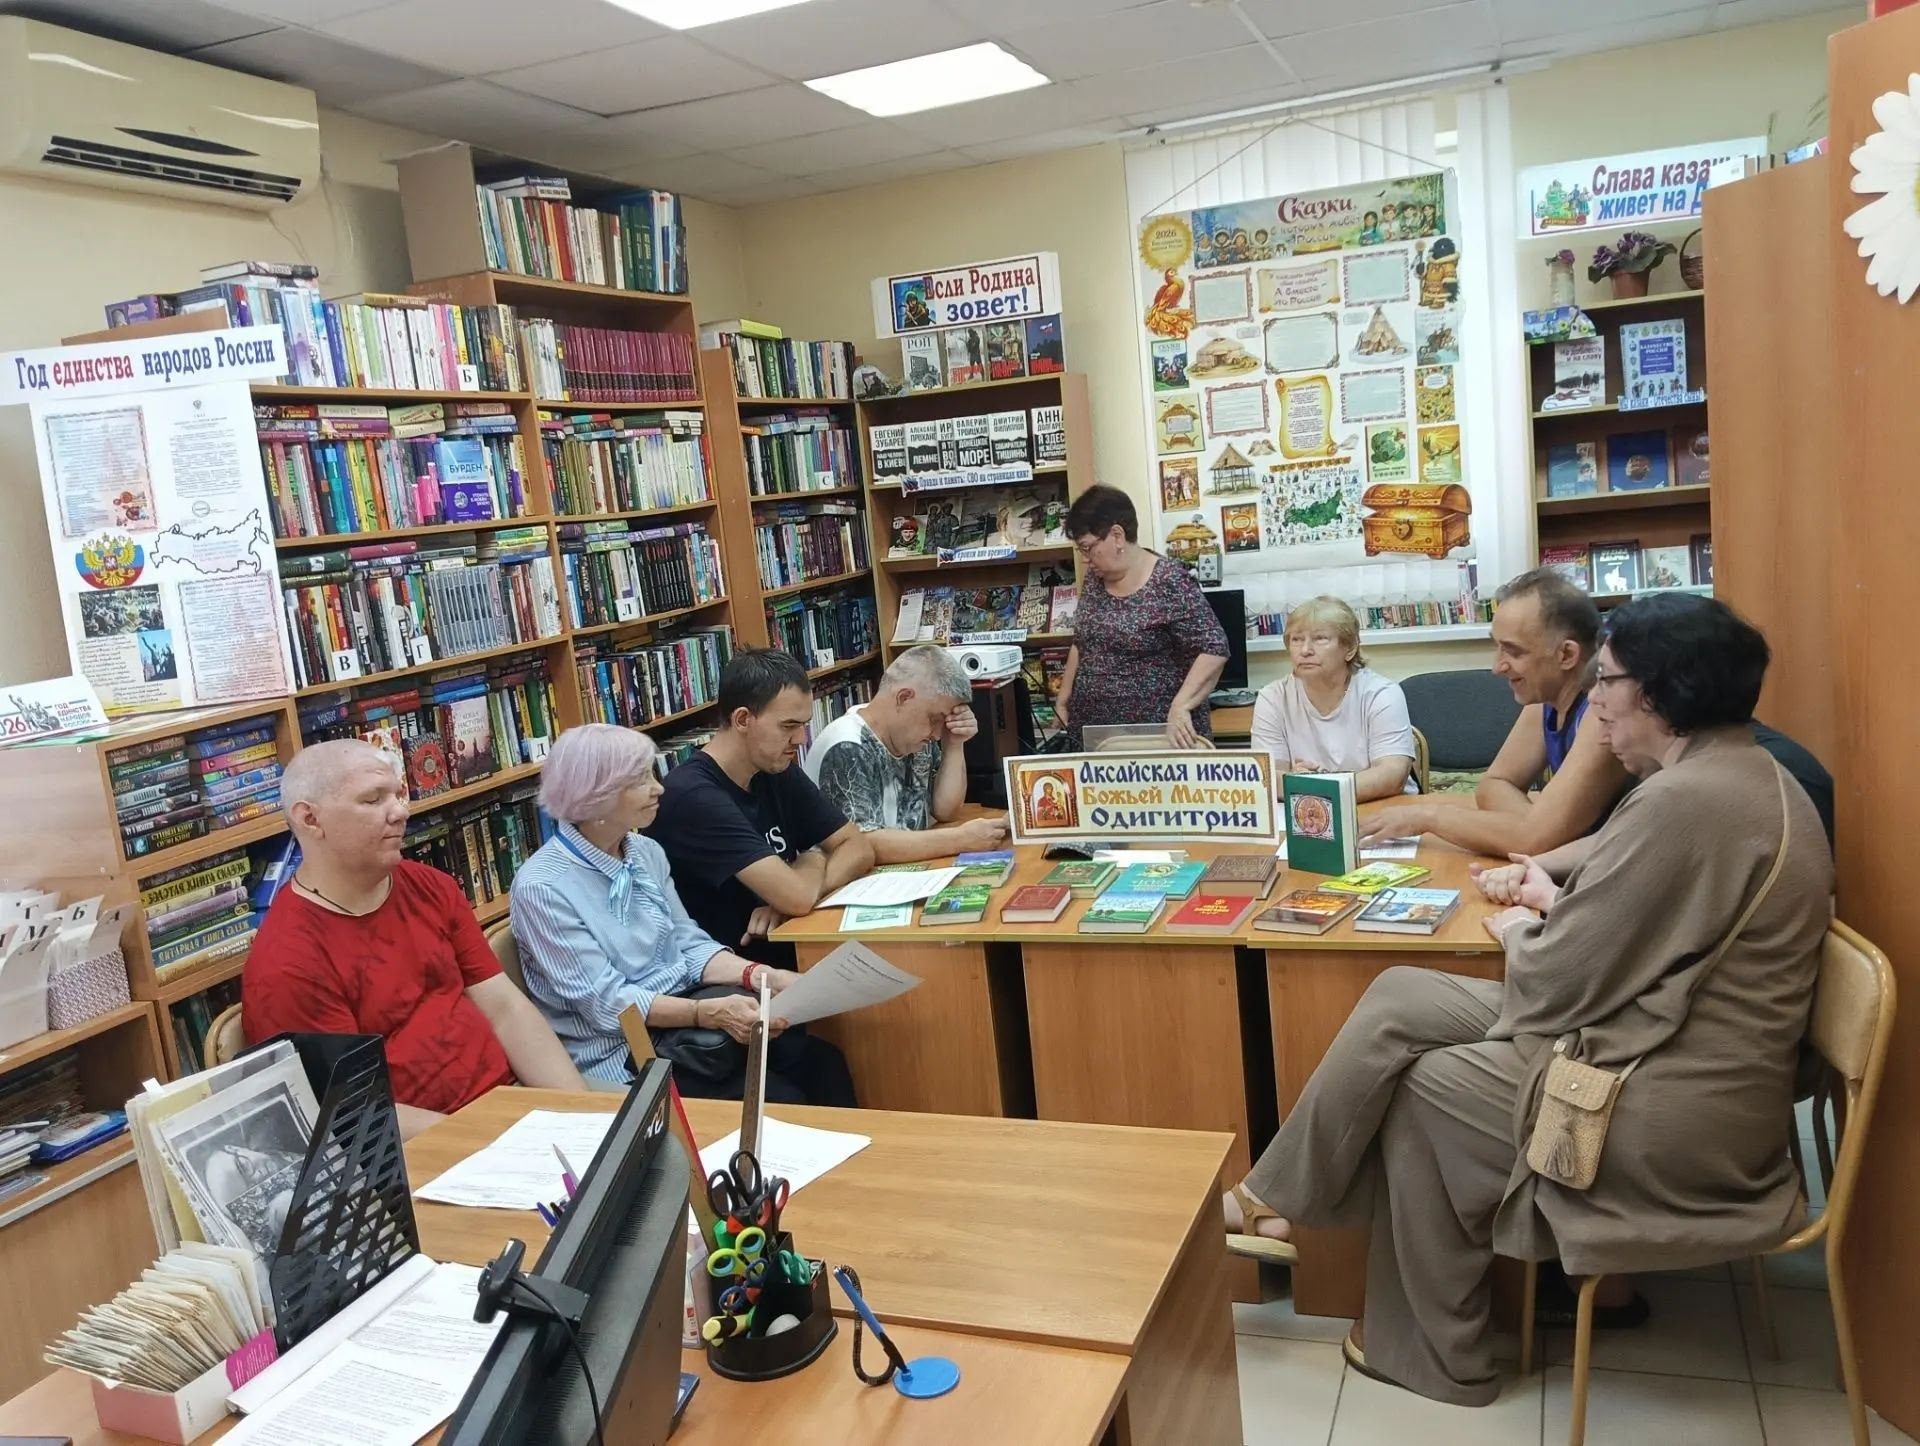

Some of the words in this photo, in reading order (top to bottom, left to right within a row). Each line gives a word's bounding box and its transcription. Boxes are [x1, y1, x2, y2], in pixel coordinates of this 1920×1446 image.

[1592, 165, 1654, 196] Слава
[1661, 156, 1731, 188] каза
[1598, 192, 1659, 221] живет
[1663, 189, 1686, 212] на
[1691, 180, 1709, 216] Д
[923, 274, 964, 300] Если
[969, 266, 1035, 295] Родина
[947, 287, 1029, 322] зовет!
[15, 357, 49, 389] Год
[53, 354, 134, 388] единства
[142, 346, 212, 383] народов
[217, 335, 275, 368] России
[463, 369, 472, 384] Б
[956, 418, 987, 428] ВАЛЕРИЯ
[957, 427, 988, 437] ТРОИЦКАЯ
[1045, 433, 1065, 443] ЗДЕС
[913, 454, 938, 465] ЛЕМНЕ
[960, 449, 990, 466] МОРЕ
[449, 463, 483, 474] БУРДЕН
[822, 475, 831, 486] С
[622, 603, 633, 616] Л
[416, 645, 425, 659] Г
[339, 655, 351, 671] В
[1080, 761, 1188, 783] Аксайская
[1197, 762, 1260, 782] икона
[1083, 784, 1162, 806] Божьей
[1170, 784, 1256, 809] Матери
[1090, 807, 1258, 832] Одигитрия
[187, 873, 216, 891] КНИГА
[158, 938, 200, 963] ЯНТАРНАЯ
[202, 929, 225, 946] КНИГА
